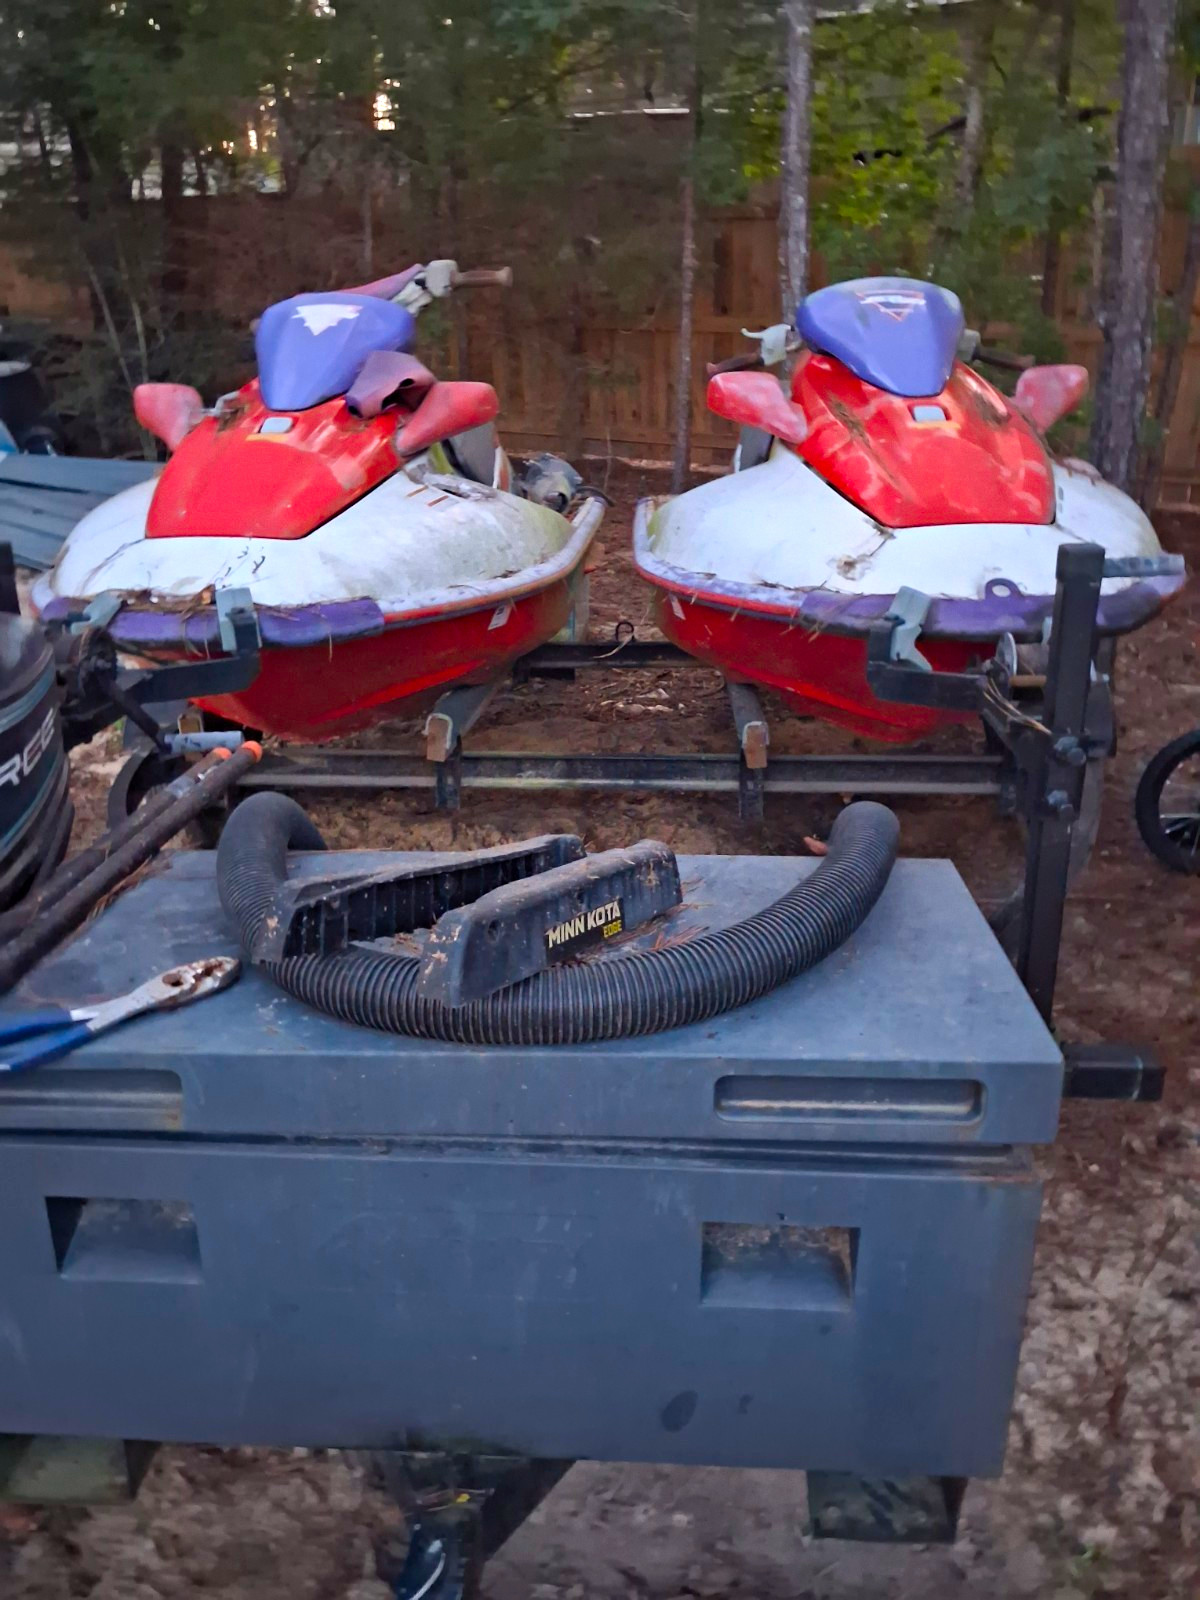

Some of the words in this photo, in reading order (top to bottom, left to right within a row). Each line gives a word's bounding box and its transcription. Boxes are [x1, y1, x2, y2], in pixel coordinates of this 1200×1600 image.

[546, 915, 585, 948] MINN
[587, 901, 621, 930] KOTA
[603, 920, 622, 938] EDGE
